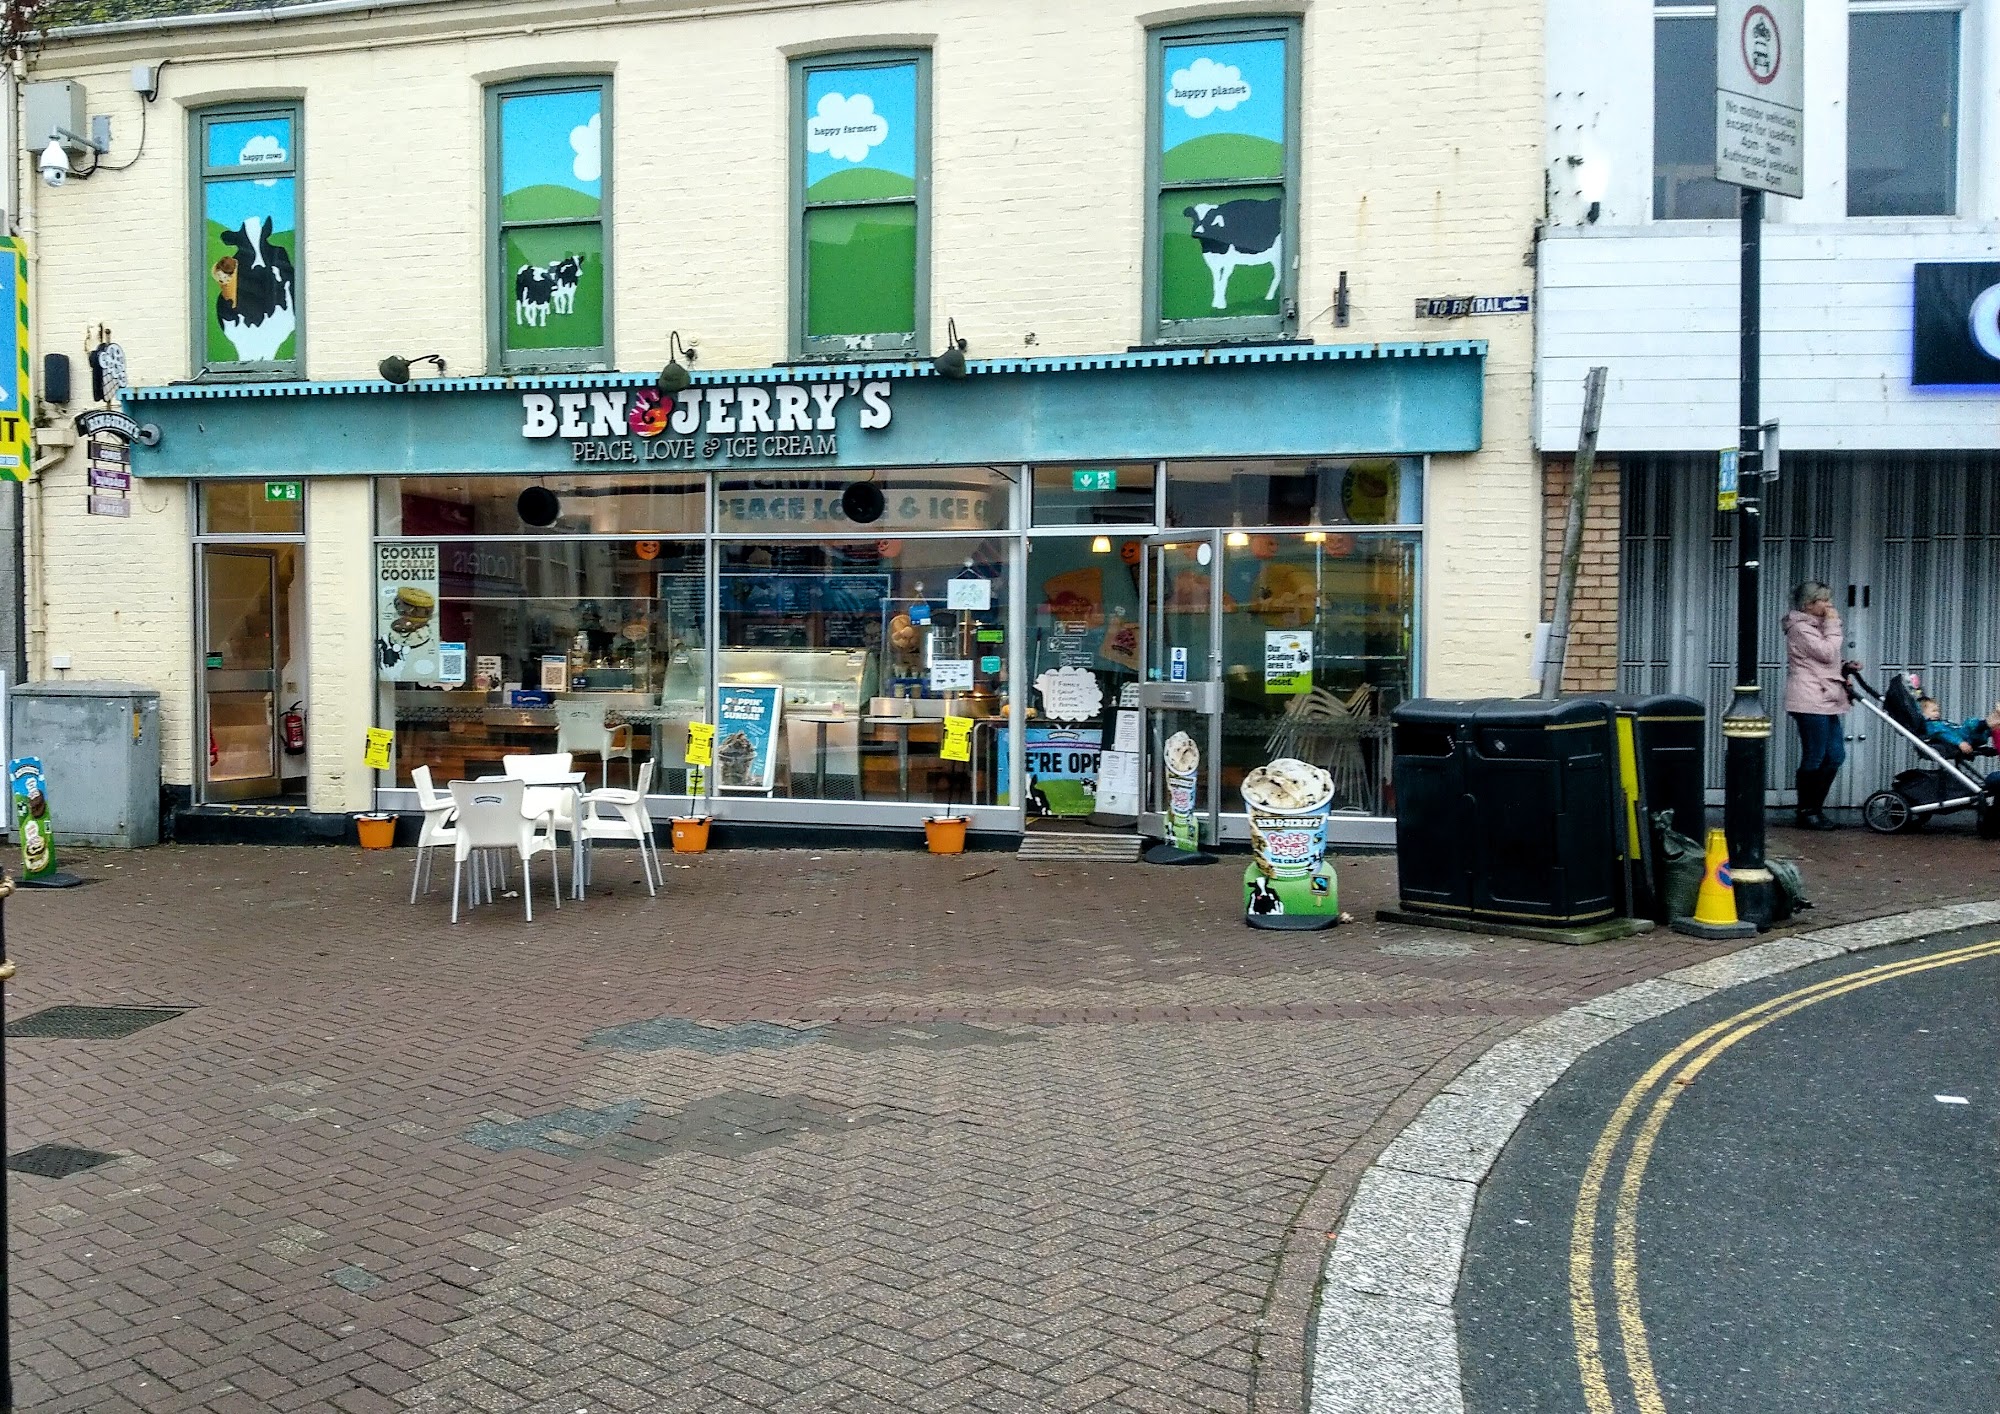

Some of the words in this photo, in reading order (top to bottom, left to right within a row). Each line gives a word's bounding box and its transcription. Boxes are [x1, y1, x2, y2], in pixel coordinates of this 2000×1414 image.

[1174, 88, 1208, 99] happy
[1211, 85, 1247, 98] planet
[814, 127, 841, 137] happy
[843, 125, 877, 134] farmers
[242, 153, 264, 162] happy
[1432, 300, 1448, 315] TO
[571, 440, 638, 464] PEACE,
[642, 438, 696, 460] LOVE
[701, 436, 720, 459] &
[725, 436, 757, 458] ICE
[761, 434, 838, 457] CREAM
[899, 496, 920, 520] &
[929, 496, 968, 520] ICE
[381, 547, 435, 560] COOKIE
[381, 559, 399, 569] ICE
[400, 559, 435, 569] CREAM
[381, 569, 436, 581] COOKIE
[1267, 644, 1281, 653] Our
[1267, 653, 1294, 662] seating
[1286, 661, 1293, 669] is
[1267, 669, 1300, 678] currently
[723, 712, 761, 720] SUNDAE
[1268, 833, 1310, 846] Cookie
[1271, 844, 1308, 858] Dough
[1284, 857, 1309, 865] CREAM
